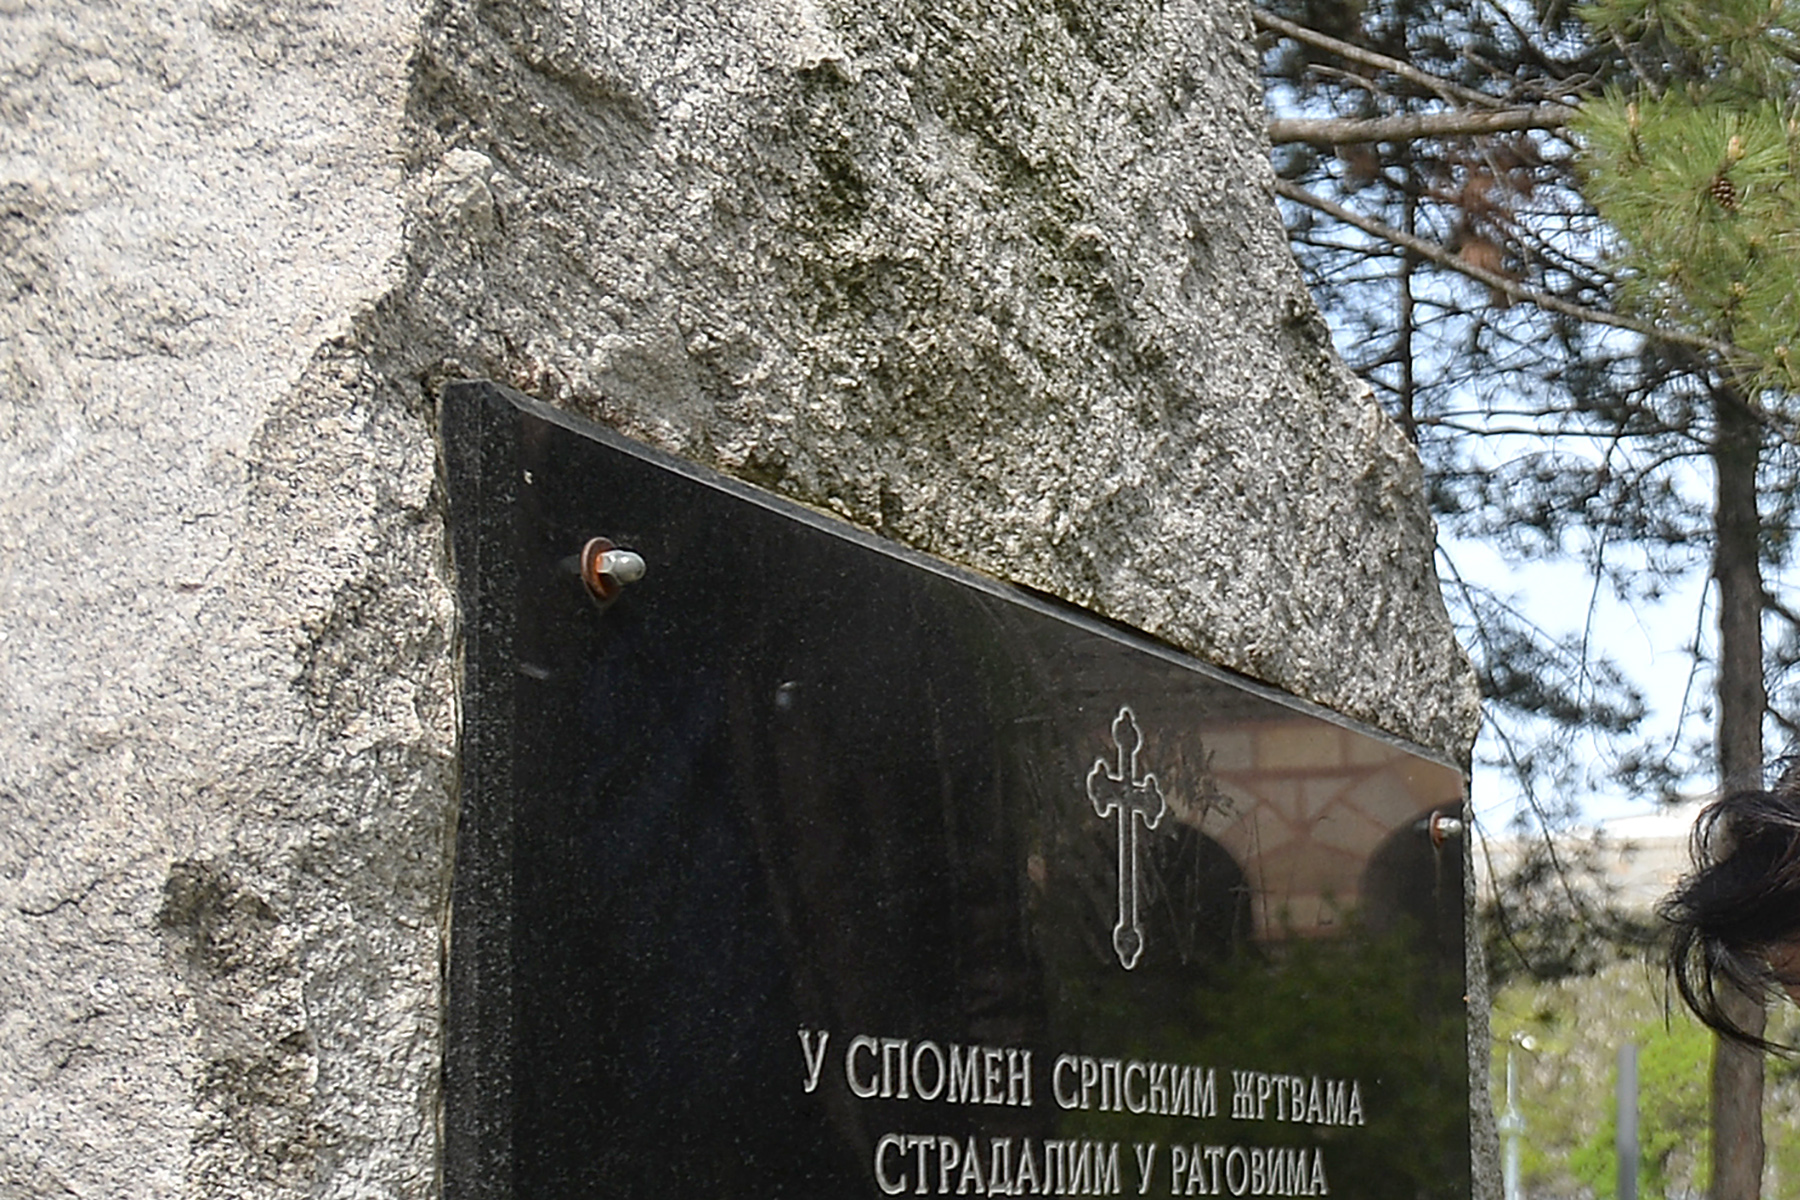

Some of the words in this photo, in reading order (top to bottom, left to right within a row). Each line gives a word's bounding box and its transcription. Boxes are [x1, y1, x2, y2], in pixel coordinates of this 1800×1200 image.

[797, 1029, 829, 1094] У
[845, 1033, 1032, 1108] СПОМЕН
[1053, 1052, 1217, 1120] СРПСКИМ
[1231, 1069, 1366, 1128] ЖРТВАМА
[875, 1133, 1121, 1199] СТРАДАЛИМ
[1133, 1143, 1154, 1196] У
[1170, 1145, 1328, 1197] РАТОВИМА
